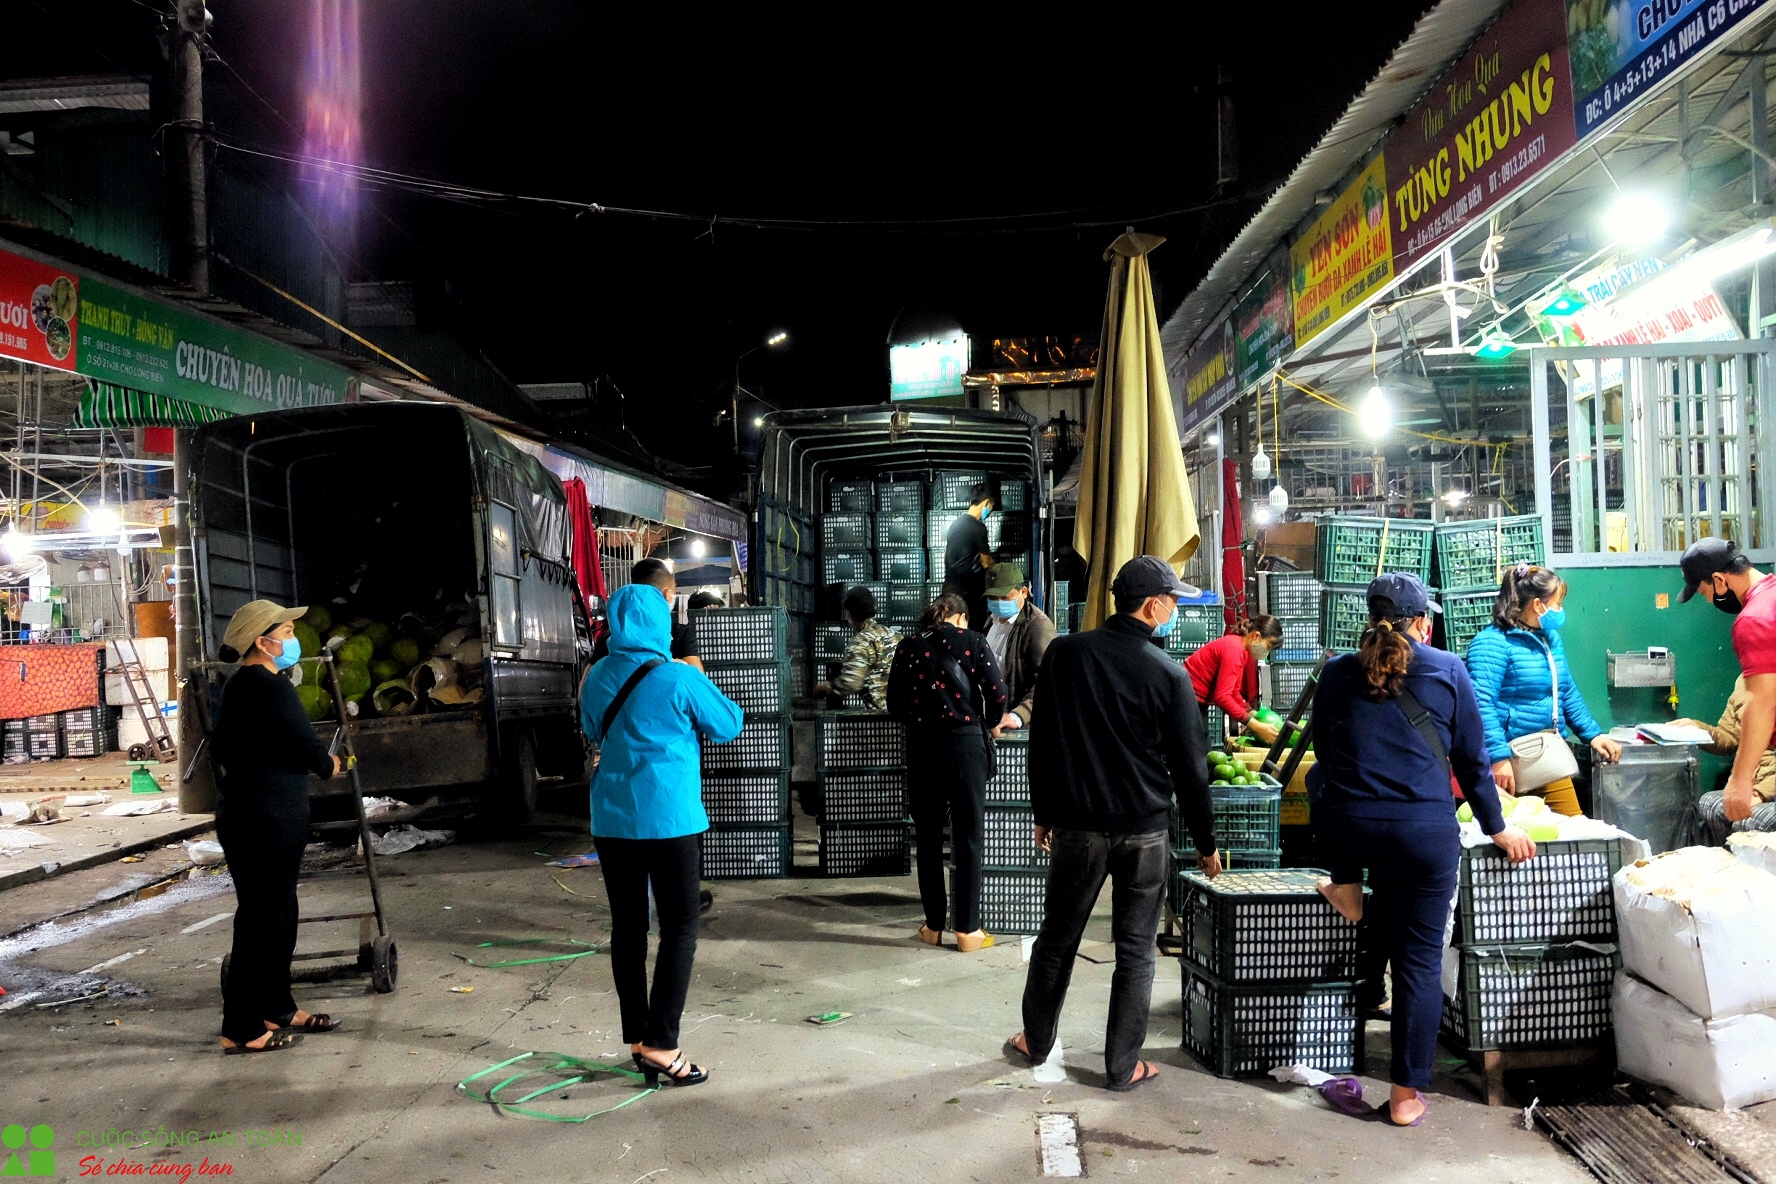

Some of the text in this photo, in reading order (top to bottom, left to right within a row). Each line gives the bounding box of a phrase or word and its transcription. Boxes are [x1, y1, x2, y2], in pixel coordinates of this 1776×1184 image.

[1614, 39, 1676, 103] 4+5+13+14
[1678, 12, 1706, 55] NHÀ
[1708, 0, 1726, 31] C6
[1396, 52, 1555, 233] TÙNG NHUNG
[176, 345, 241, 393] CHUYÊN
[243, 362, 273, 402] HOA
[276, 366, 303, 409] QUẢ
